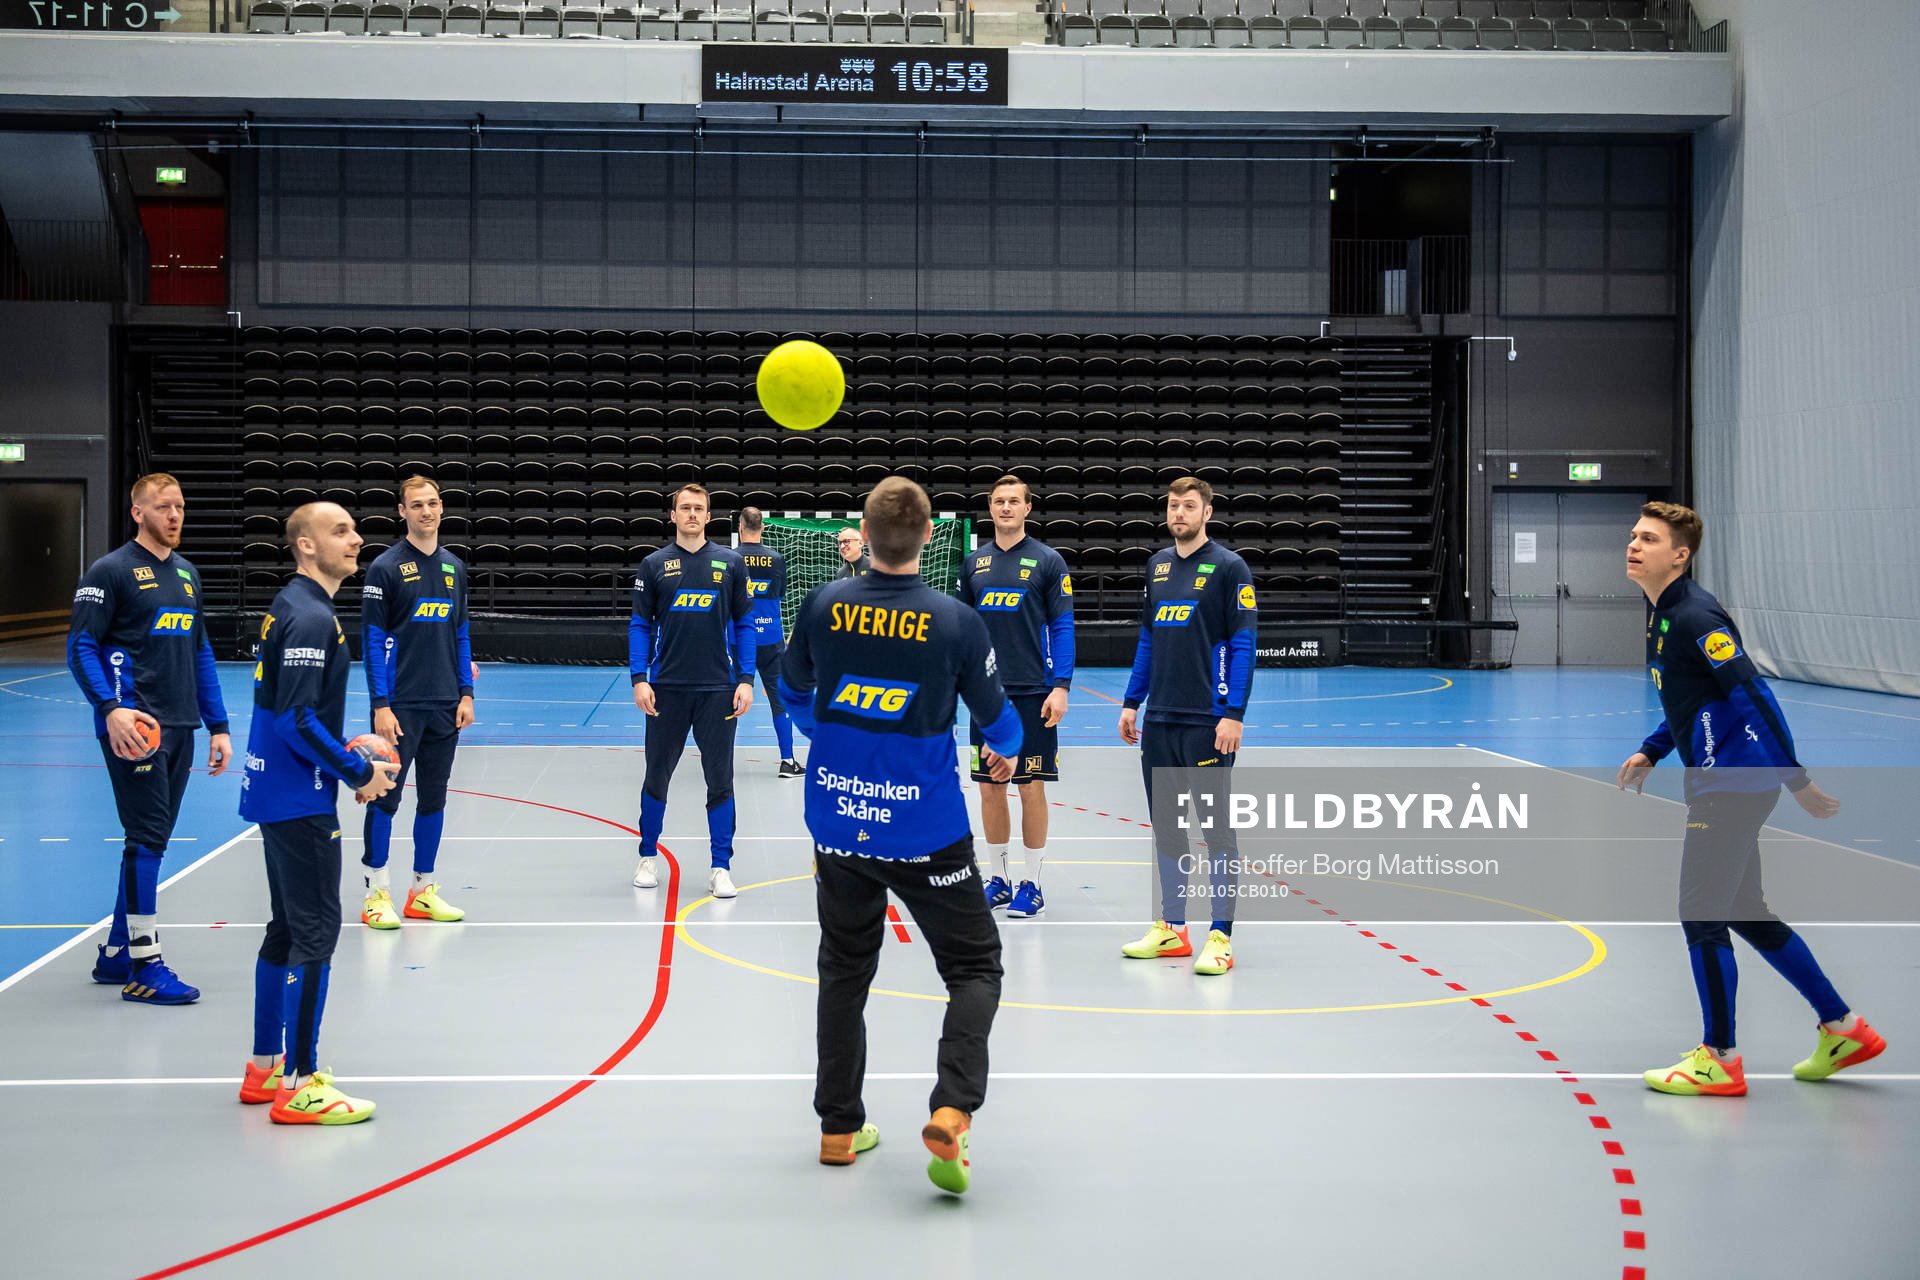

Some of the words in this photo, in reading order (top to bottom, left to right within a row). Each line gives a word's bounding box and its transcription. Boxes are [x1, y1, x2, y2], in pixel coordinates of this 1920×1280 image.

[715, 71, 809, 92] Halmstad
[814, 73, 874, 92] Arena
[890, 61, 989, 92] 10:58
[744, 556, 773, 568] ERIGE
[80, 587, 105, 598] STENA
[673, 594, 713, 607] ATG
[981, 592, 1021, 606] ATG
[414, 603, 451, 618] ATG
[1154, 605, 1192, 622] ATG
[155, 613, 194, 630] ATG
[831, 602, 932, 642] SVERIGE
[294, 648, 326, 660] STENA
[1256, 647, 1286, 657] mstad
[1288, 647, 1319, 657] Arena
[835, 683, 909, 713] ATG
[816, 766, 921, 801] Sparbanken
[836, 796, 892, 823] Skåne
